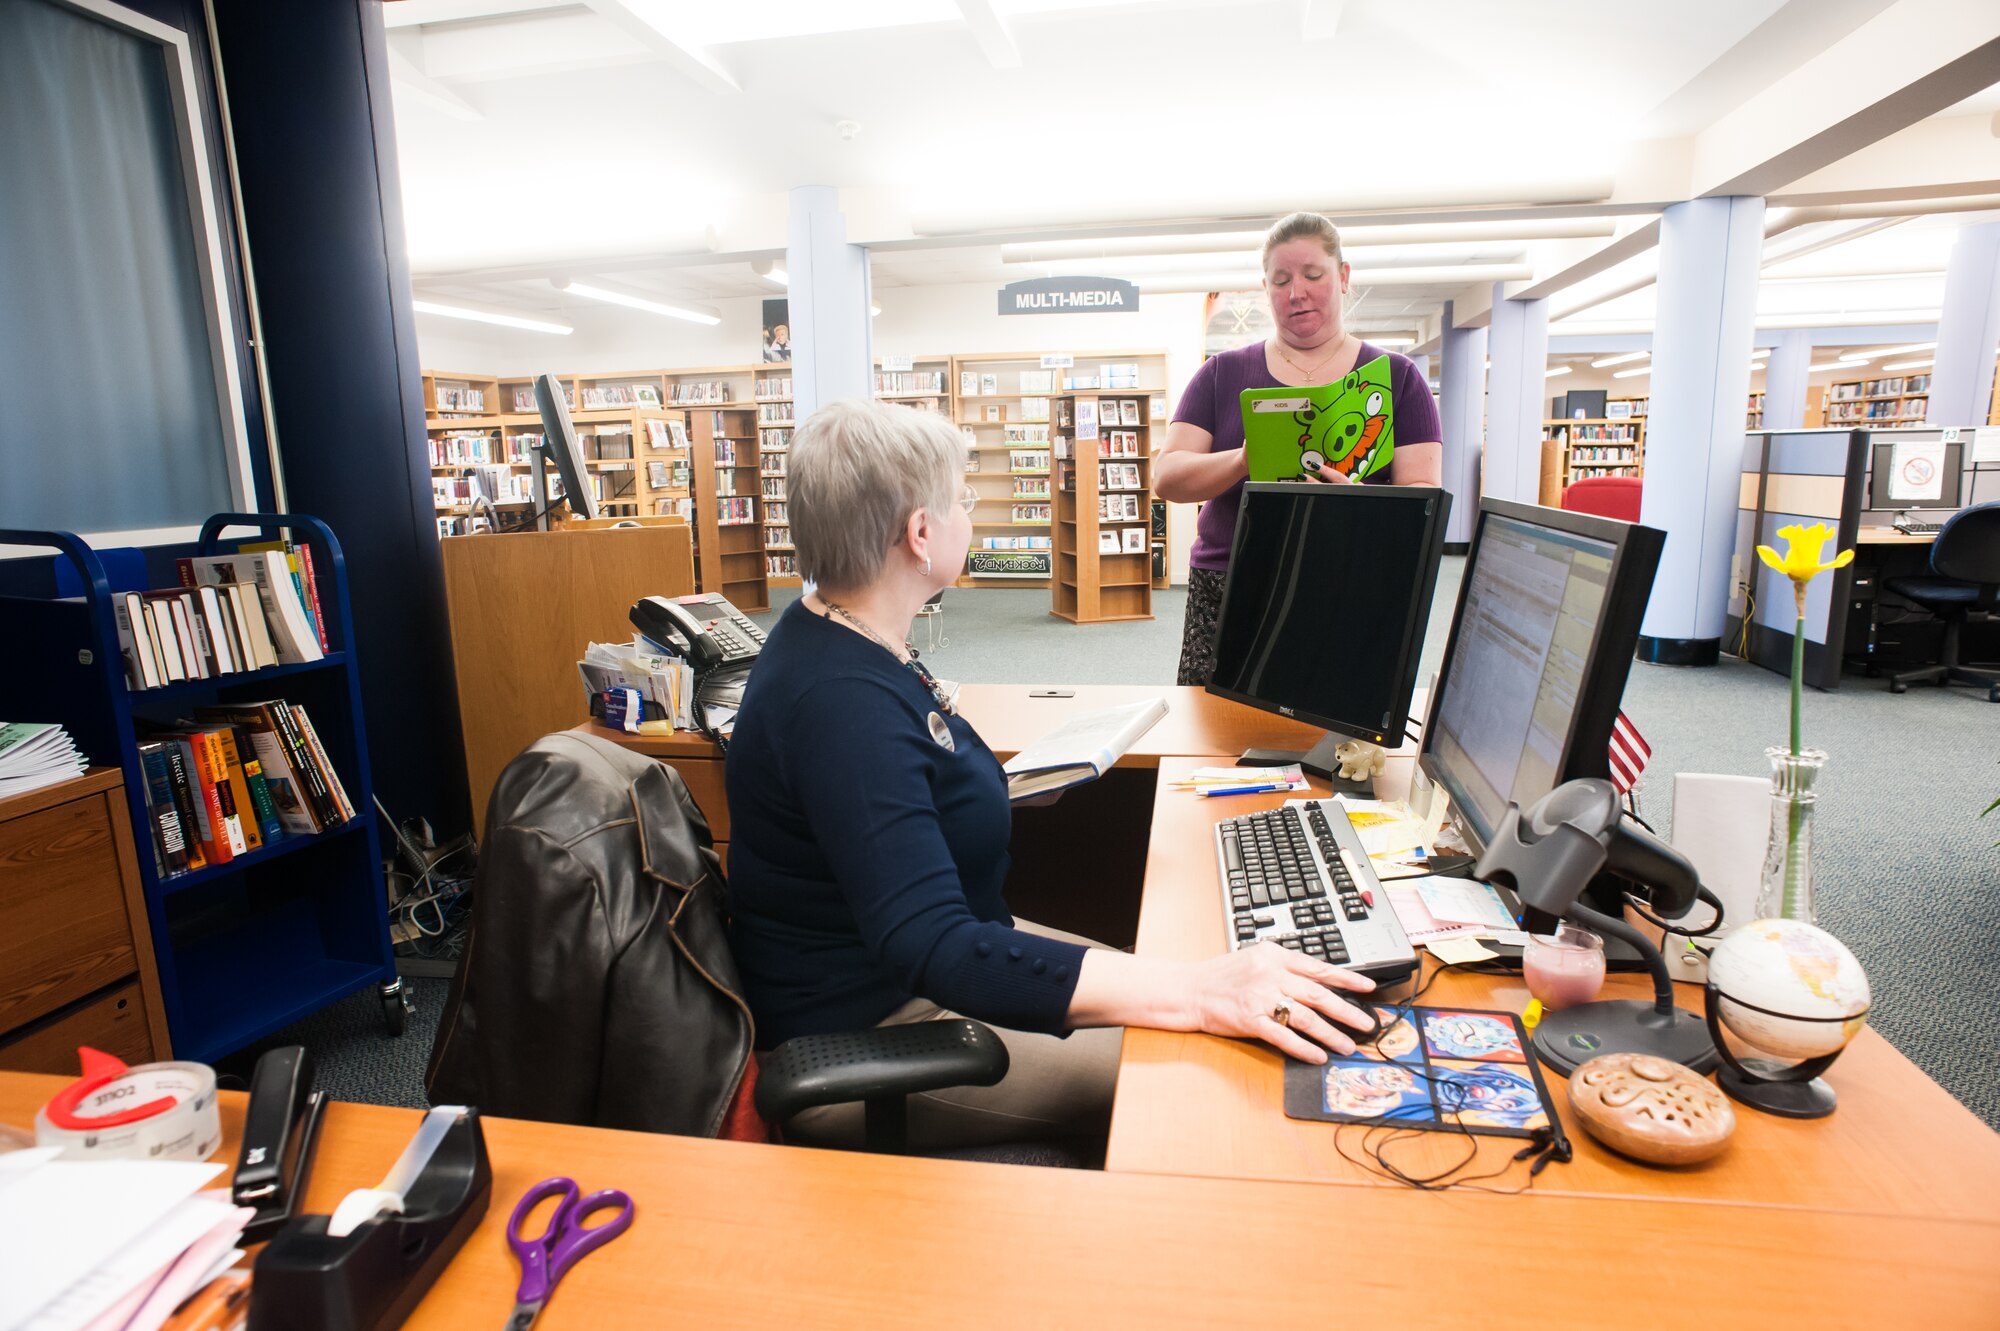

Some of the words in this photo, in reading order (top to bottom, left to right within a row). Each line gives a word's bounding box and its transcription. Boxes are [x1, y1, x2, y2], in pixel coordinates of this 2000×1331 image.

[1016, 291, 1123, 308] MULTI-MEDIA
[1077, 403, 1091, 419] New
[1944, 430, 1957, 439] 13
[171, 753, 185, 784] Heretic
[210, 788, 222, 810] PANIC
[218, 817, 229, 840] LEVEL
[159, 811, 185, 853] CONTAGION
